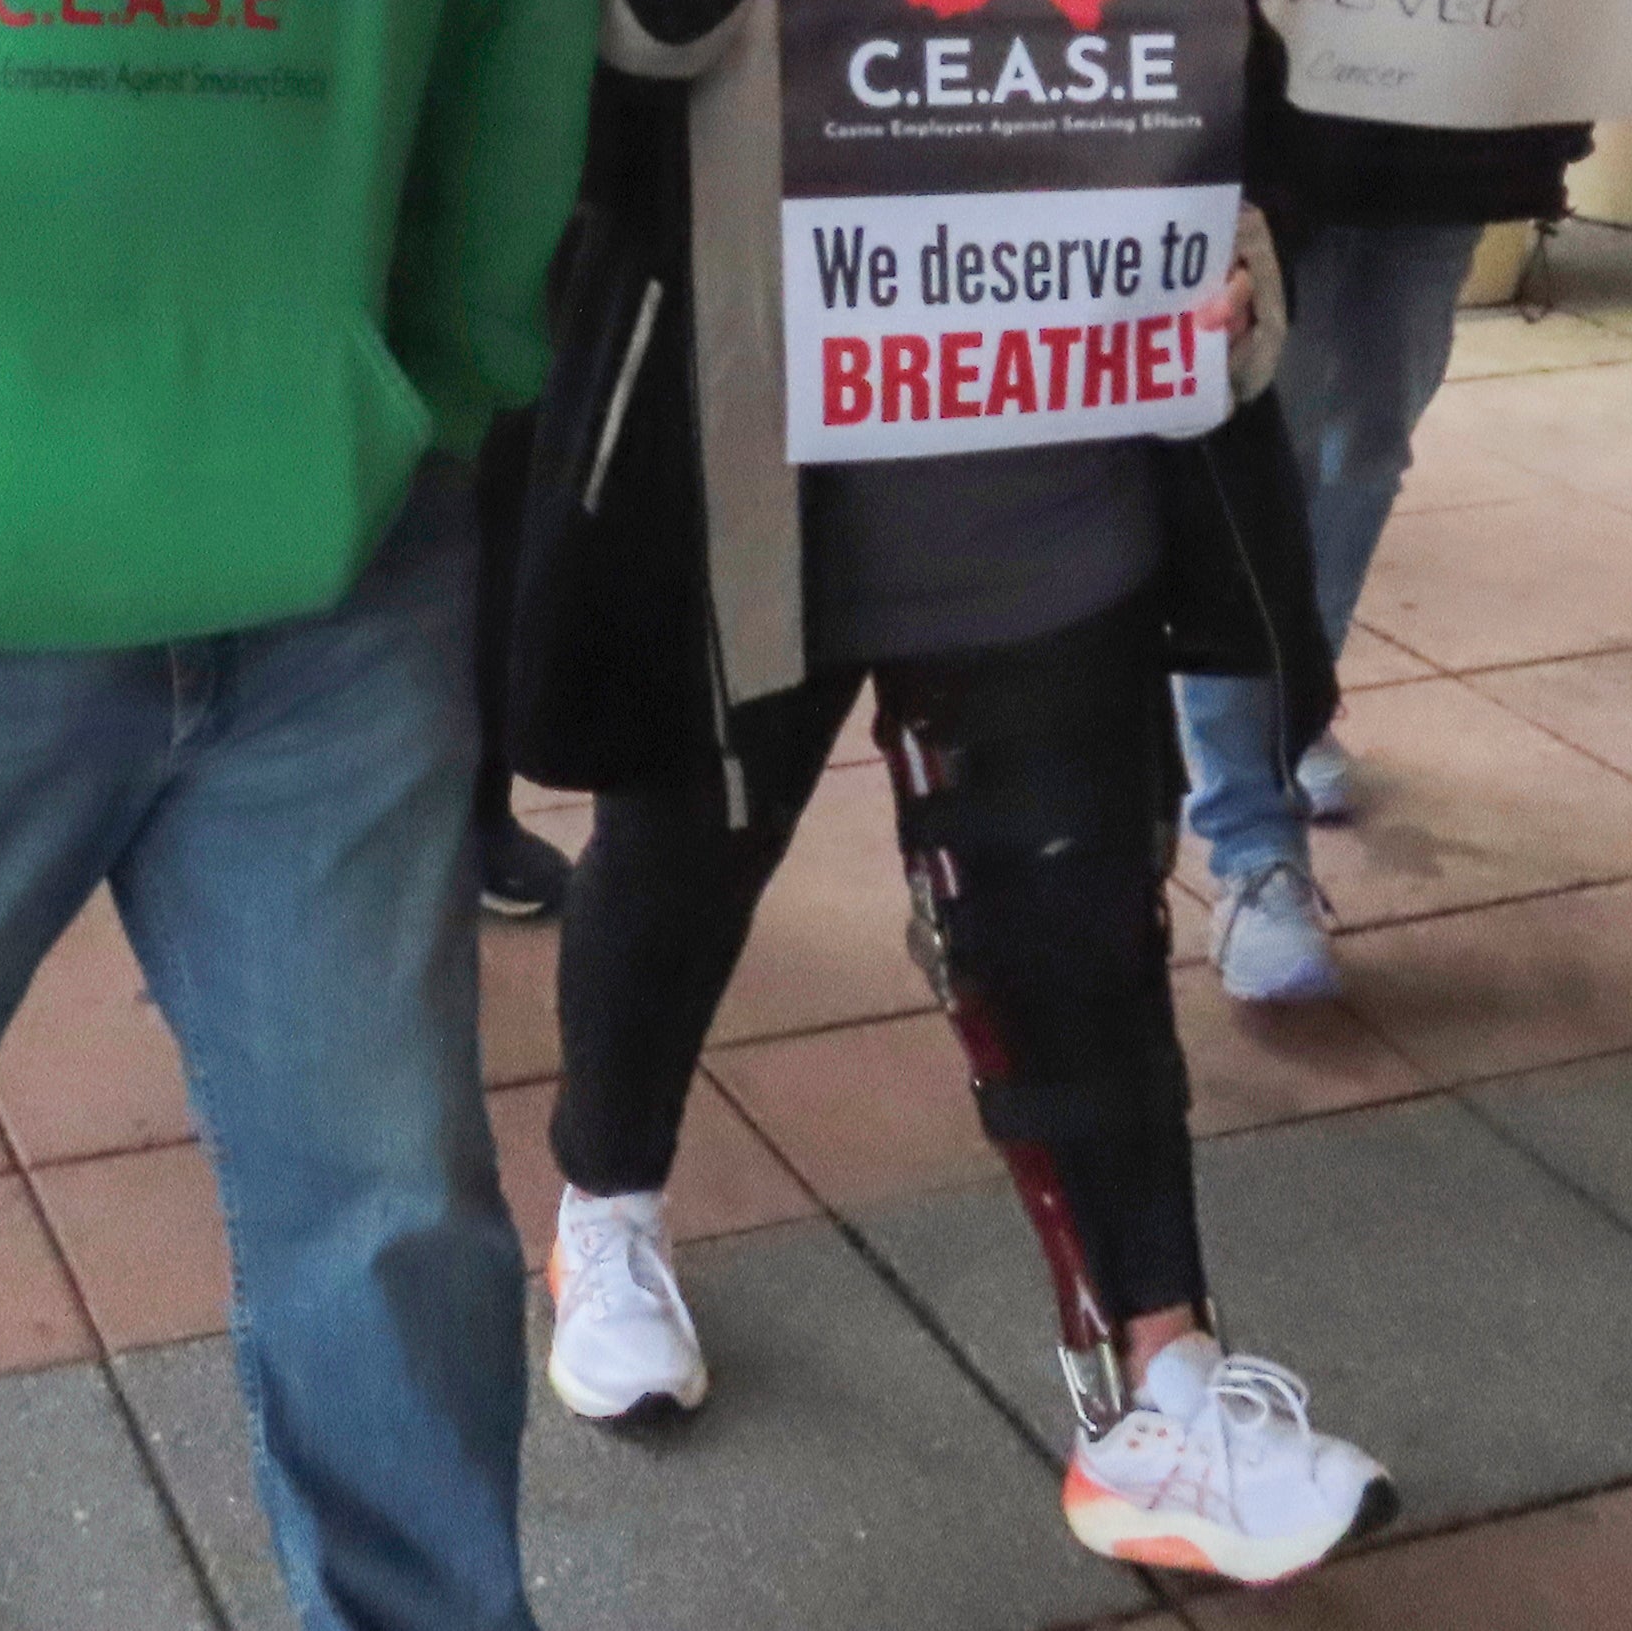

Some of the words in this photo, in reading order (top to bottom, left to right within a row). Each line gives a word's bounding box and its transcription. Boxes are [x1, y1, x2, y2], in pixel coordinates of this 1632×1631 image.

[848, 33, 1178, 108] C.E.A.S.E
[813, 226, 899, 309] We
[920, 223, 1143, 306] deserve
[1161, 220, 1209, 291] to
[821, 311, 1199, 428] BREATHE!
